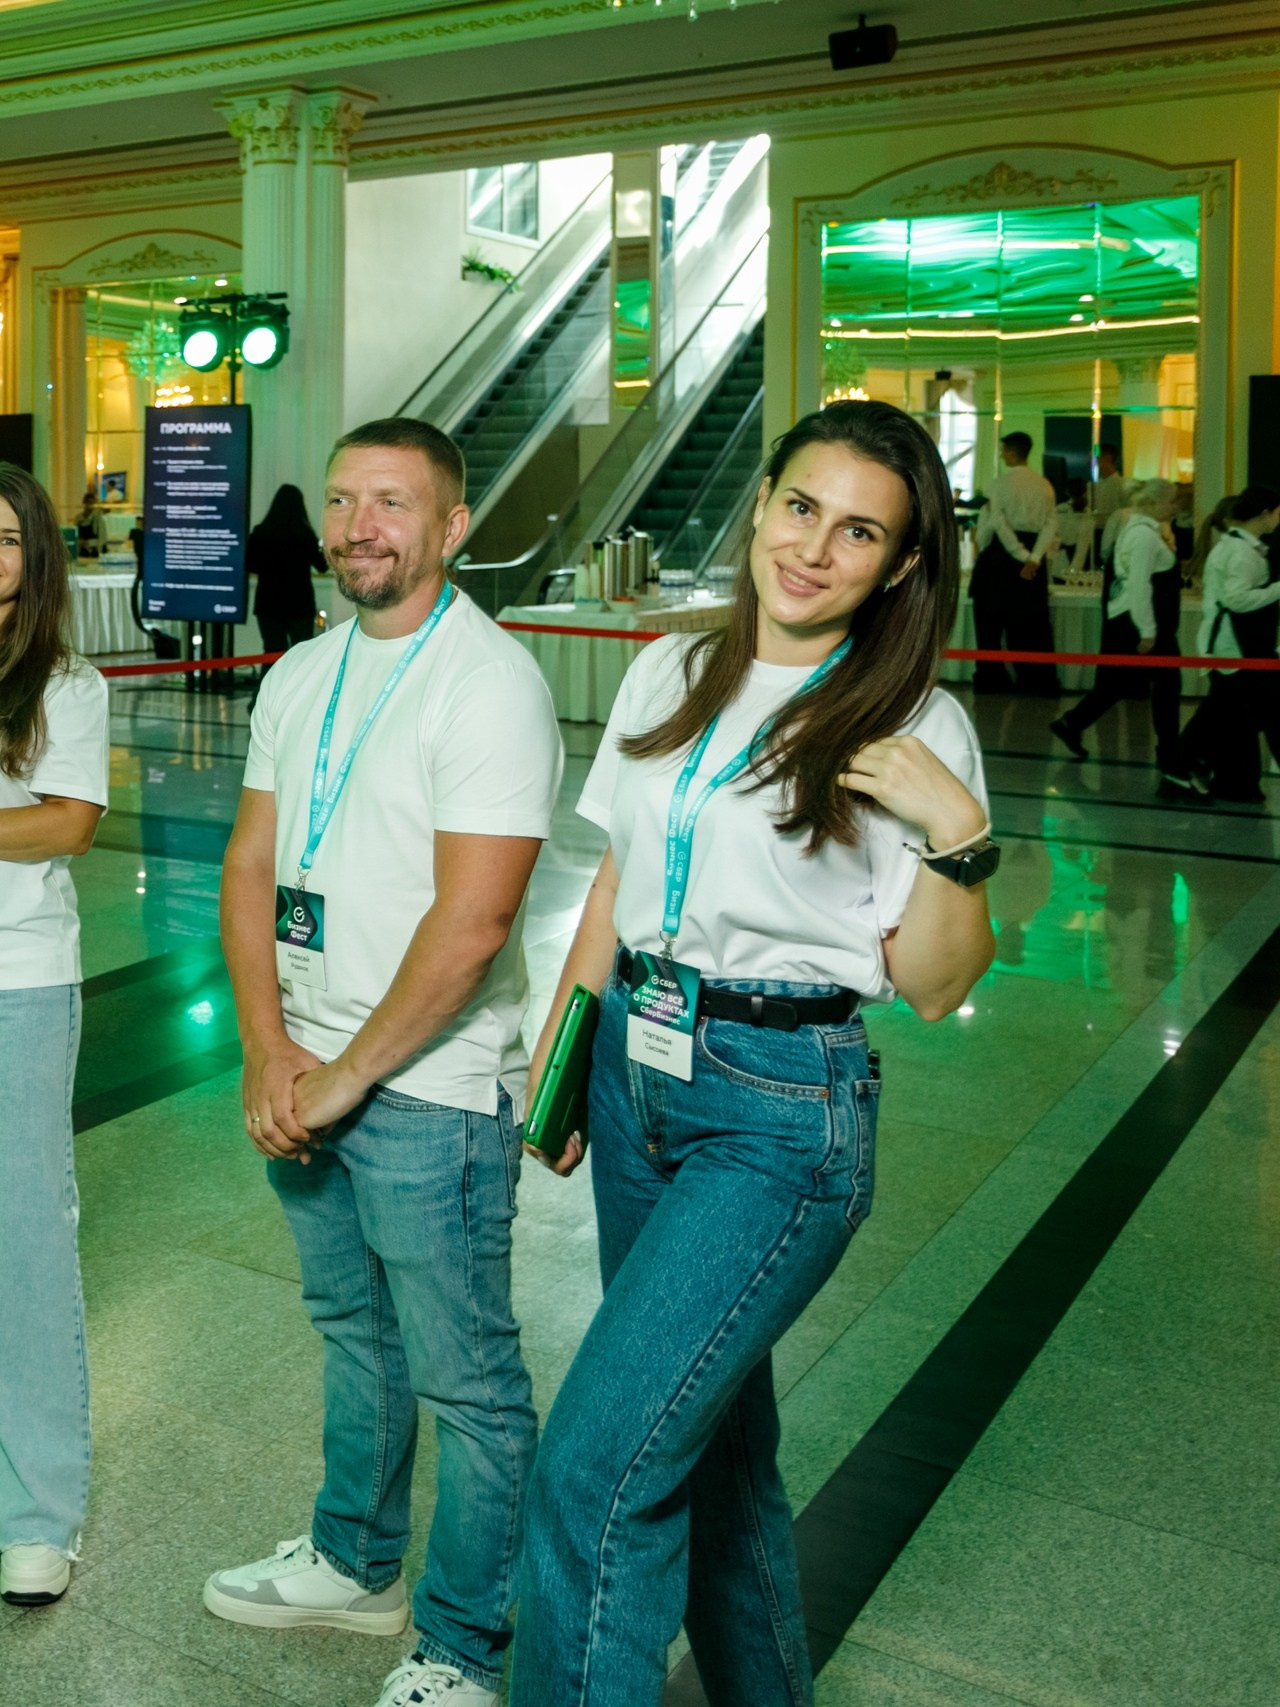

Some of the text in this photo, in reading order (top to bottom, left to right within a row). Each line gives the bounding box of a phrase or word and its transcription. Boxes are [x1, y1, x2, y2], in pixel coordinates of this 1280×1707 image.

[160, 422, 232, 434] ПРОГРАММА
[669, 890, 680, 914] Бизн
[287, 921, 311, 934] Бизнес
[290, 930, 308, 941] Фест
[659, 979, 678, 989] СБЕР
[641, 986, 684, 1006] ЗНАЮ ВСЁ
[633, 993, 690, 1018] О ПРОДУКТАХ
[640, 1005, 681, 1025] СберБизнес
[642, 1029, 672, 1045] Наталья
